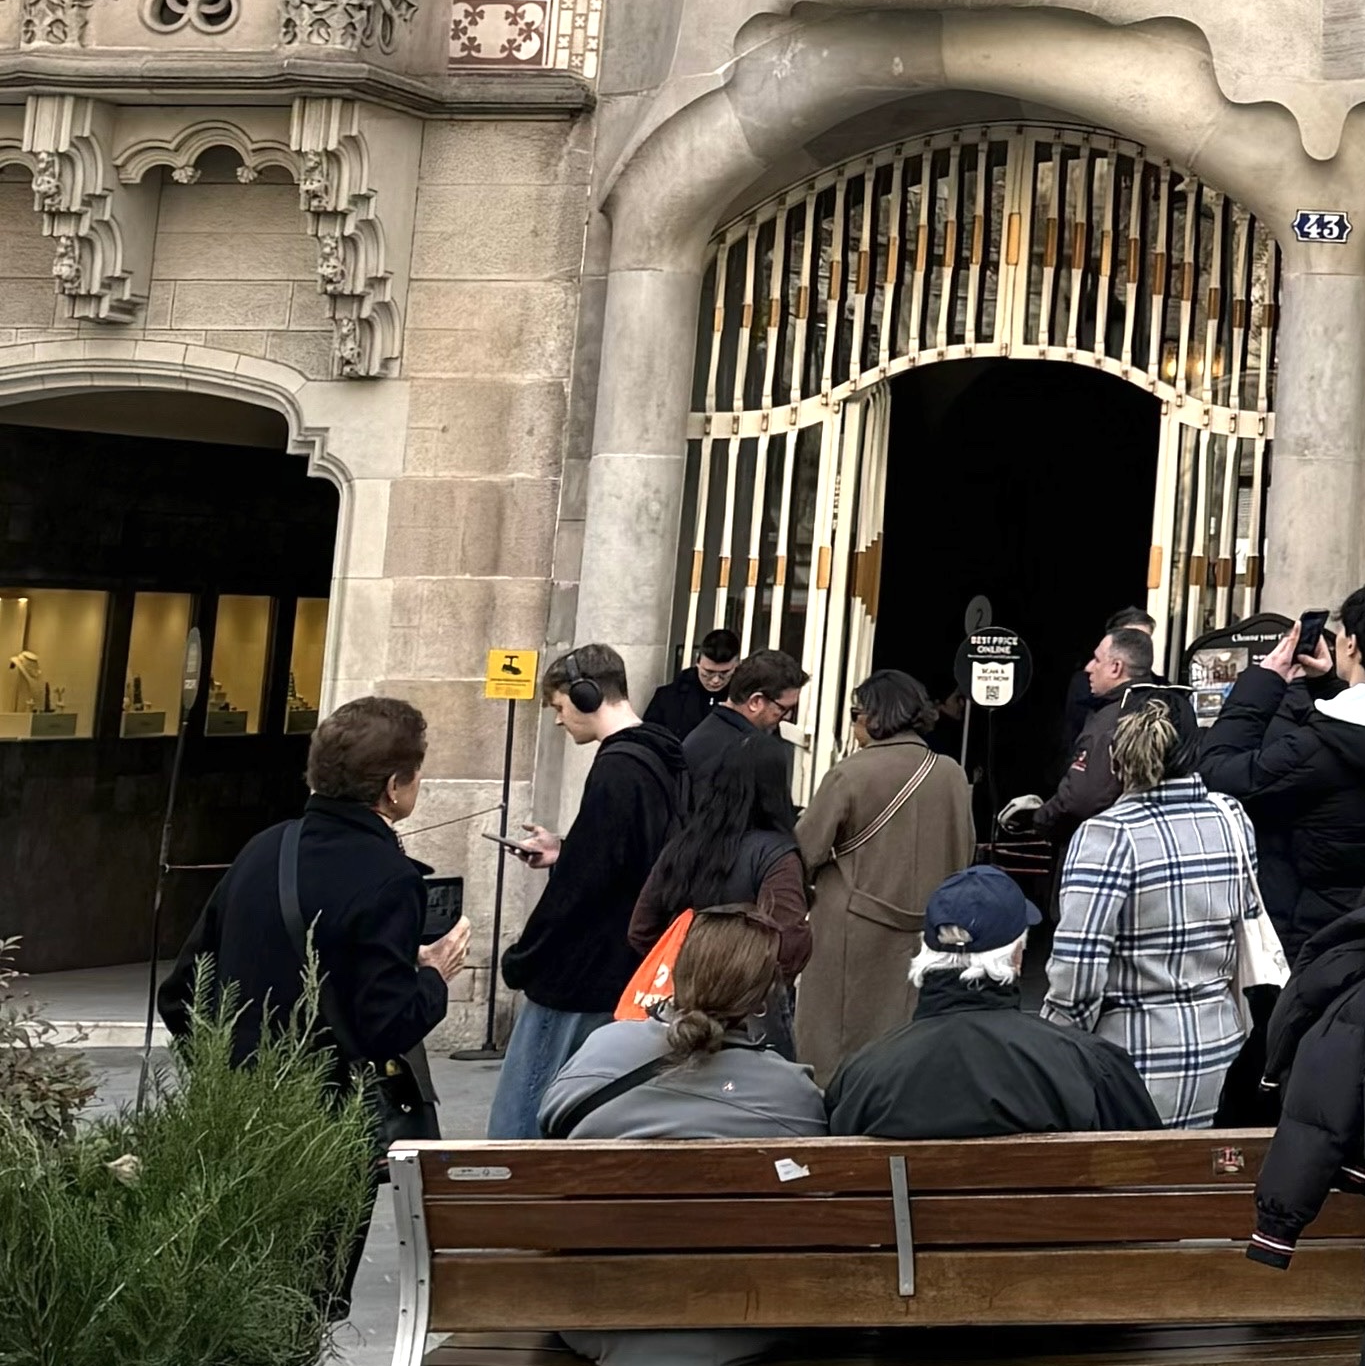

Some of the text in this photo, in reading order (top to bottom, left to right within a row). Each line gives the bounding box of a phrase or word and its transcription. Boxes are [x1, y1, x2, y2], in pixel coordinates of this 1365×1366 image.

[1303, 215, 1340, 238] 43
[970, 636, 1019, 646] BEST PRICE
[976, 645, 1012, 655] ONLINE
